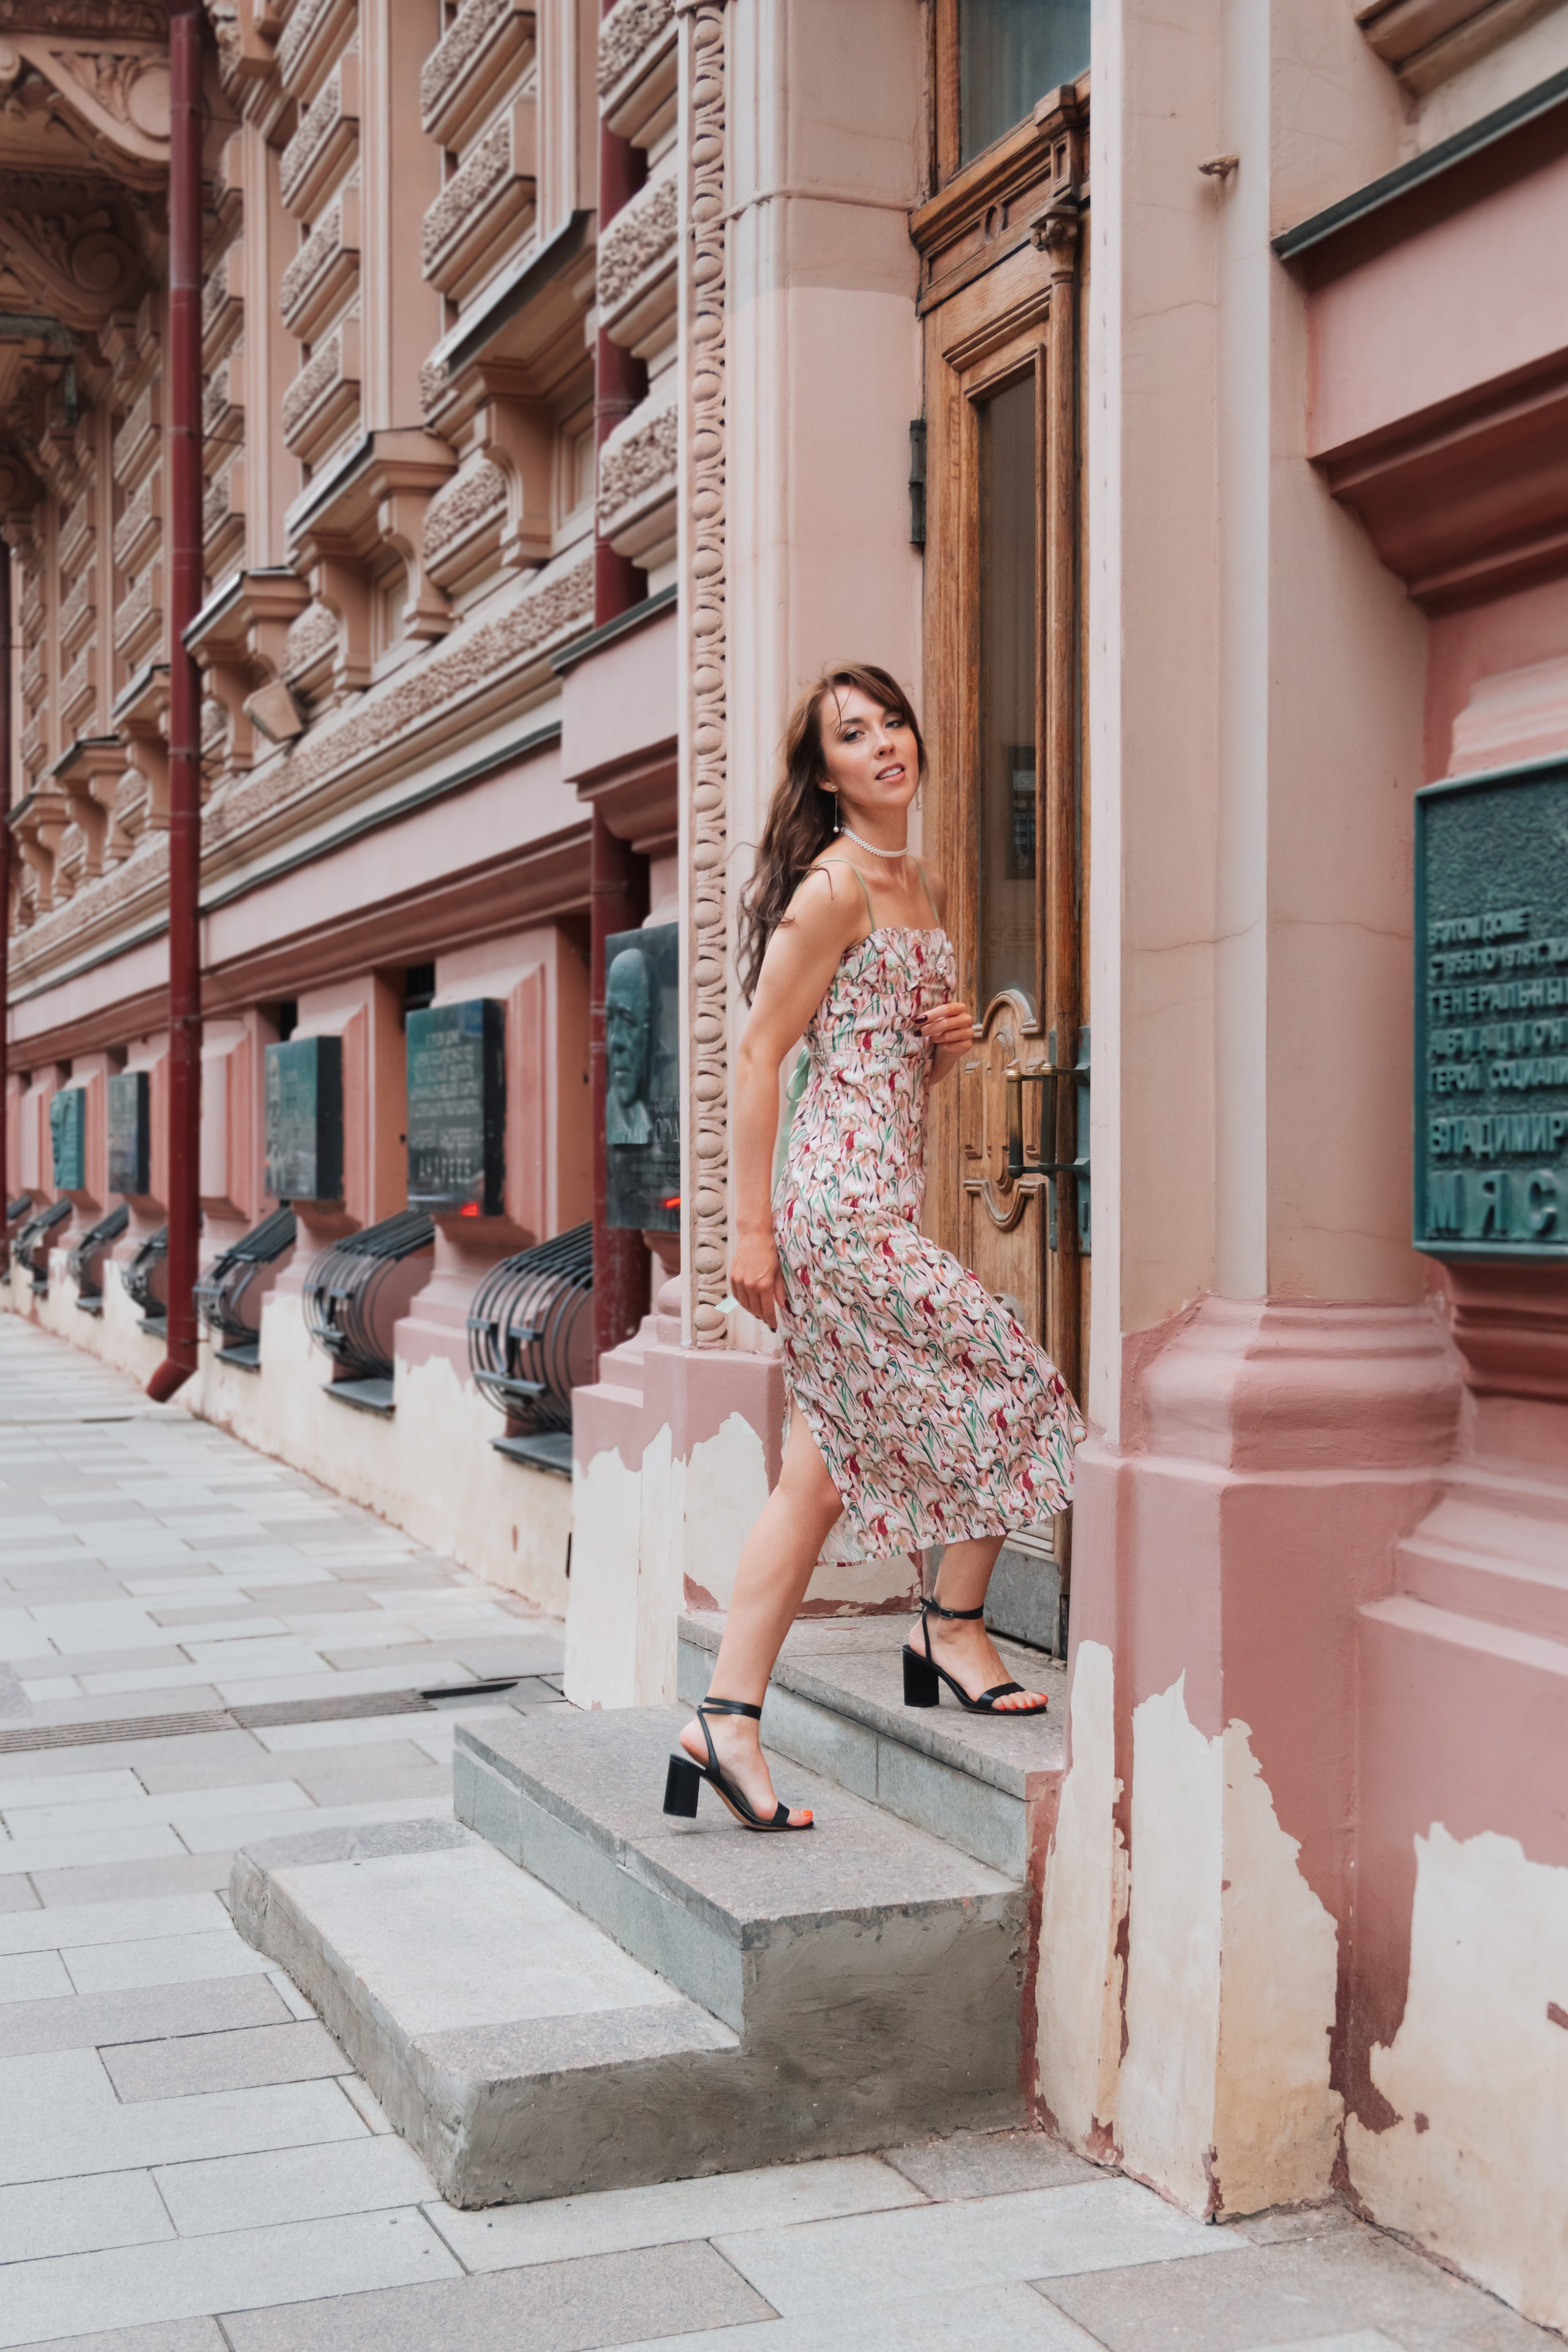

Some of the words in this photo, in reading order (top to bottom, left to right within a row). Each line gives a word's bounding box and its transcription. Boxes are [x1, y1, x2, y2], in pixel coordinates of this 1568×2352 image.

[1482, 907, 1531, 941] ДОМЕ
[1428, 976, 1568, 1014] ГЕНЕРАЛЬНЫ
[1428, 1061, 1483, 1093] ГЕРОЙ
[1429, 1113, 1567, 1158] ВЛАДИМИР
